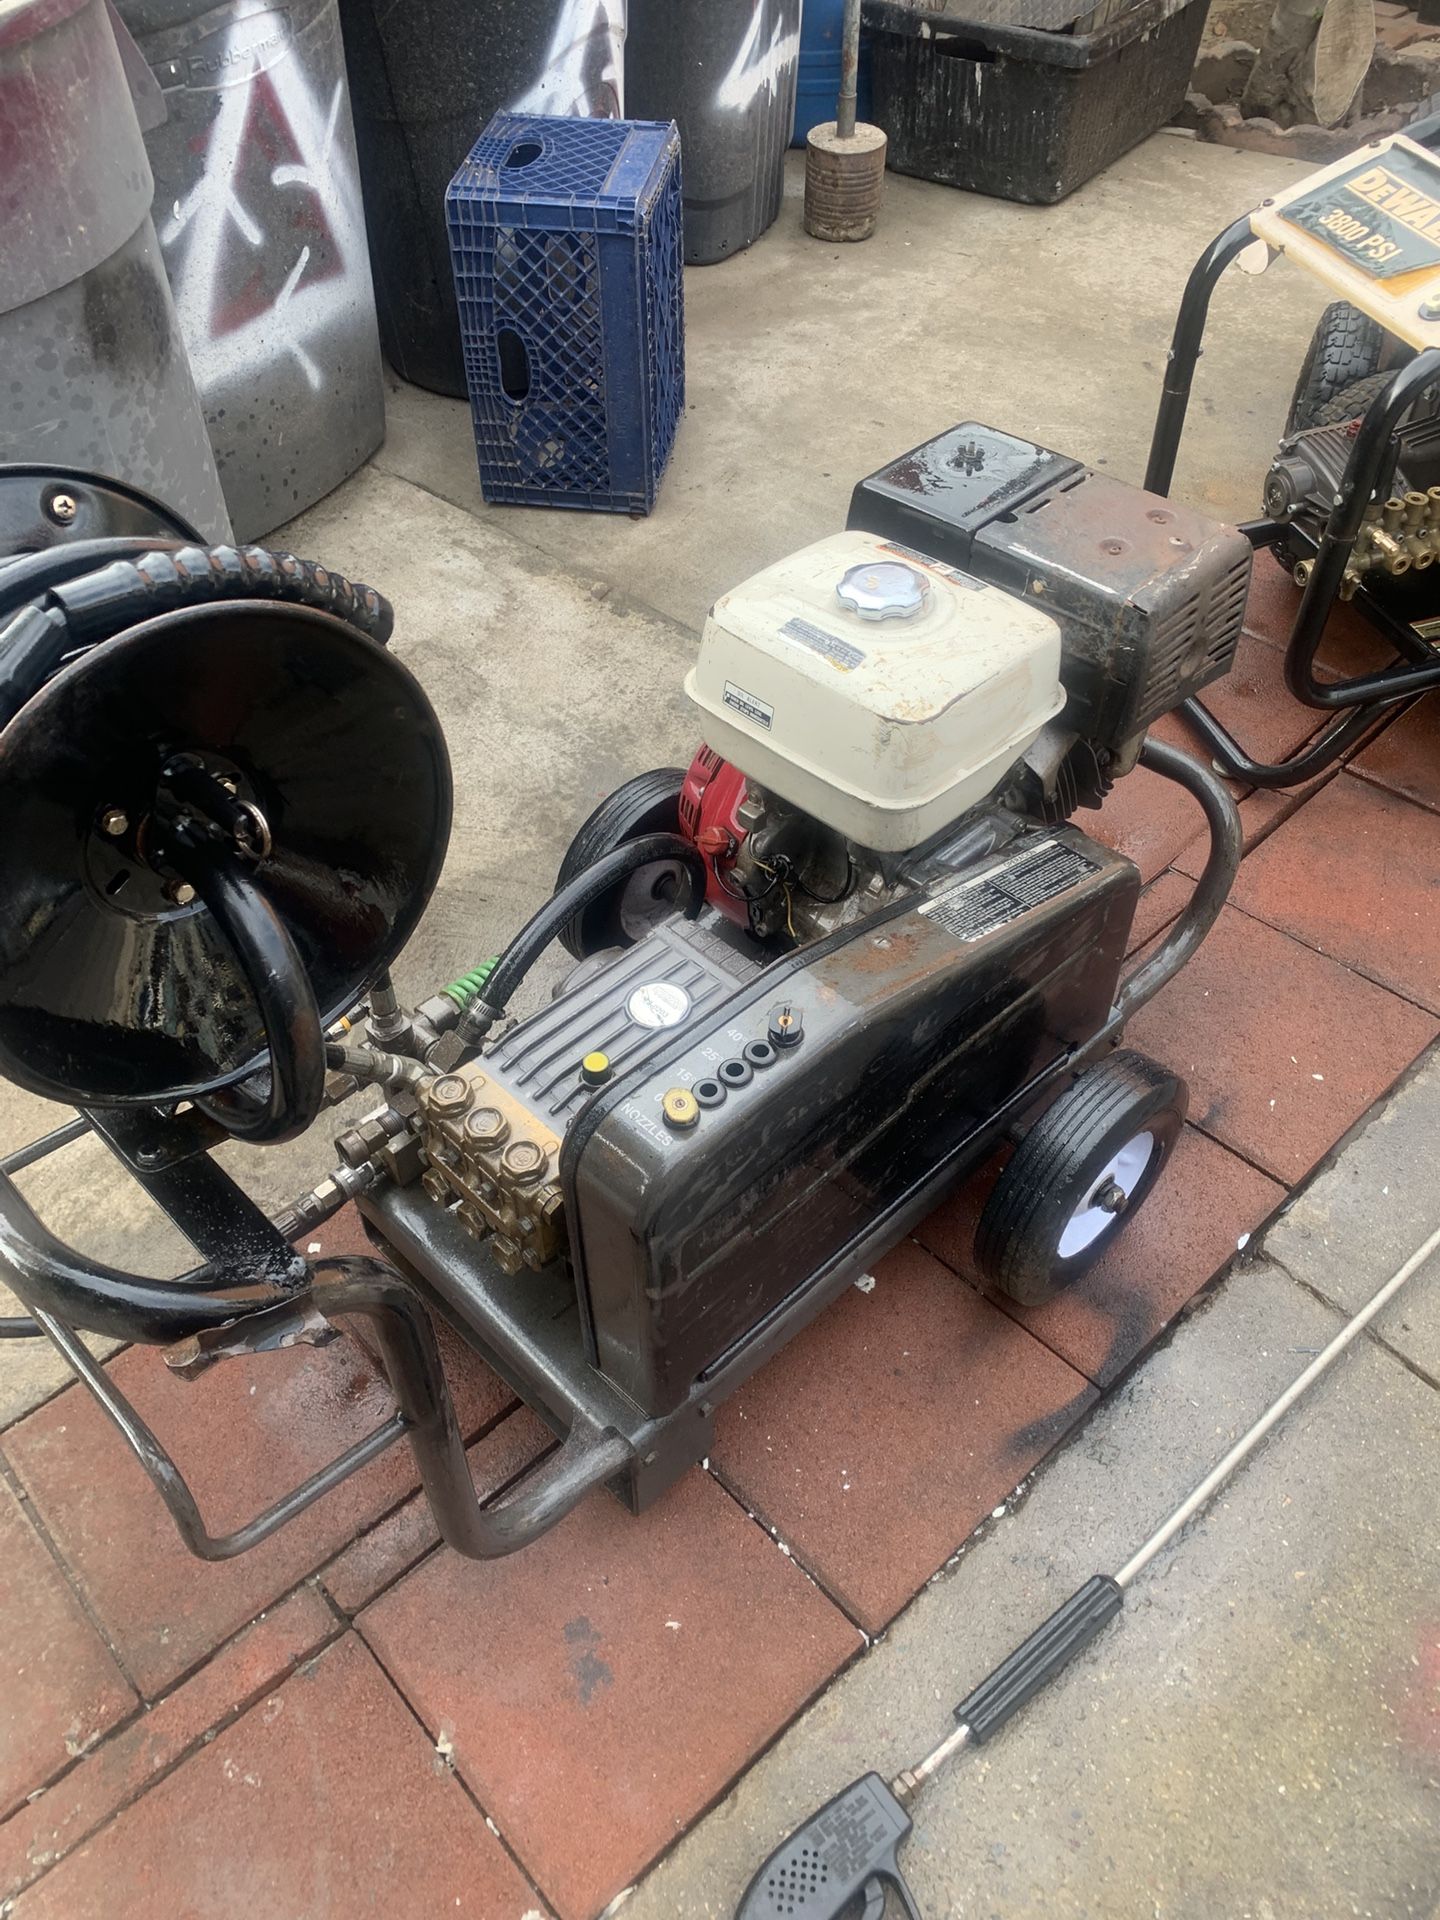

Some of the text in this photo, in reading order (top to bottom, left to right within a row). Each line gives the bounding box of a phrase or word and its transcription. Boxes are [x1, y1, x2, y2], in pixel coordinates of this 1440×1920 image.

[1348, 168, 1440, 243] DEWAL
[1319, 209, 1403, 262] 3800 PSI
[620, 1102, 674, 1146] NOZZLES
